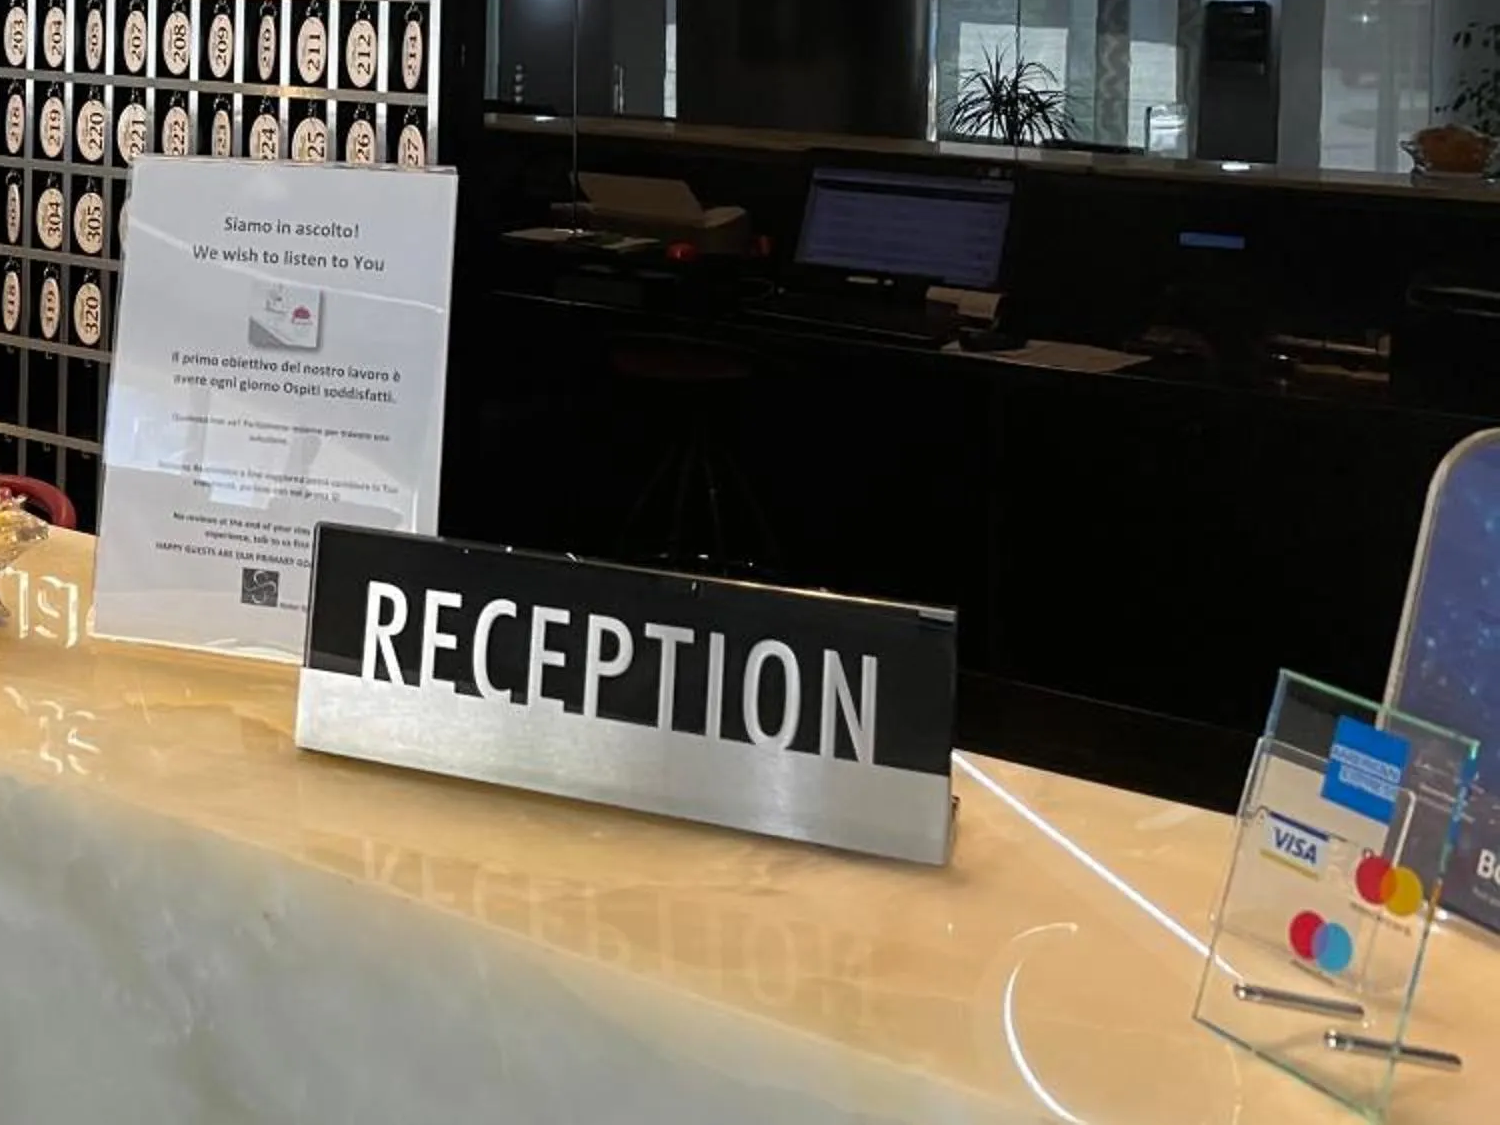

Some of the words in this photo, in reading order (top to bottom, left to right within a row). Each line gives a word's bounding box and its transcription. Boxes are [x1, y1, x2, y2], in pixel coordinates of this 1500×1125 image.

[50, 19, 62, 56] 204
[131, 23, 143, 61] 207
[172, 24, 187, 63] 208
[215, 26, 228, 66] 209
[307, 33, 321, 71] 211
[357, 33, 372, 76] 212
[407, 34, 418, 76] 214
[49, 108, 61, 147] 219
[89, 112, 104, 151] 220
[130, 119, 146, 154] 221
[307, 130, 326, 161] 25
[355, 133, 371, 163] 26
[407, 137, 420, 166] 27
[48, 201, 61, 237] 304
[87, 205, 101, 243] 305
[224, 216, 272, 234] Siamo
[276, 219, 291, 235] in
[295, 222, 359, 239] ascolto!
[193, 244, 218, 261] We
[223, 246, 258, 263] wish
[263, 250, 279, 265] to
[284, 250, 327, 268] listen
[332, 254, 349, 269] to
[354, 255, 385, 273] You
[85, 296, 99, 335] 320
[182, 353, 219, 369] primo
[221, 355, 278, 372] obiettivo
[281, 361, 301, 374] del
[303, 364, 345, 379] nostro
[347, 366, 389, 382] lavoro
[174, 374, 208, 387] avere
[210, 376, 237, 392] ogni
[239, 379, 279, 393] giorno
[283, 381, 321, 398] Ospiti
[324, 386, 396, 404] soddisfatti.
[296, 558, 311, 568] GO
[361, 580, 878, 765] RECEPTION
[1273, 826, 1318, 865] VISA
